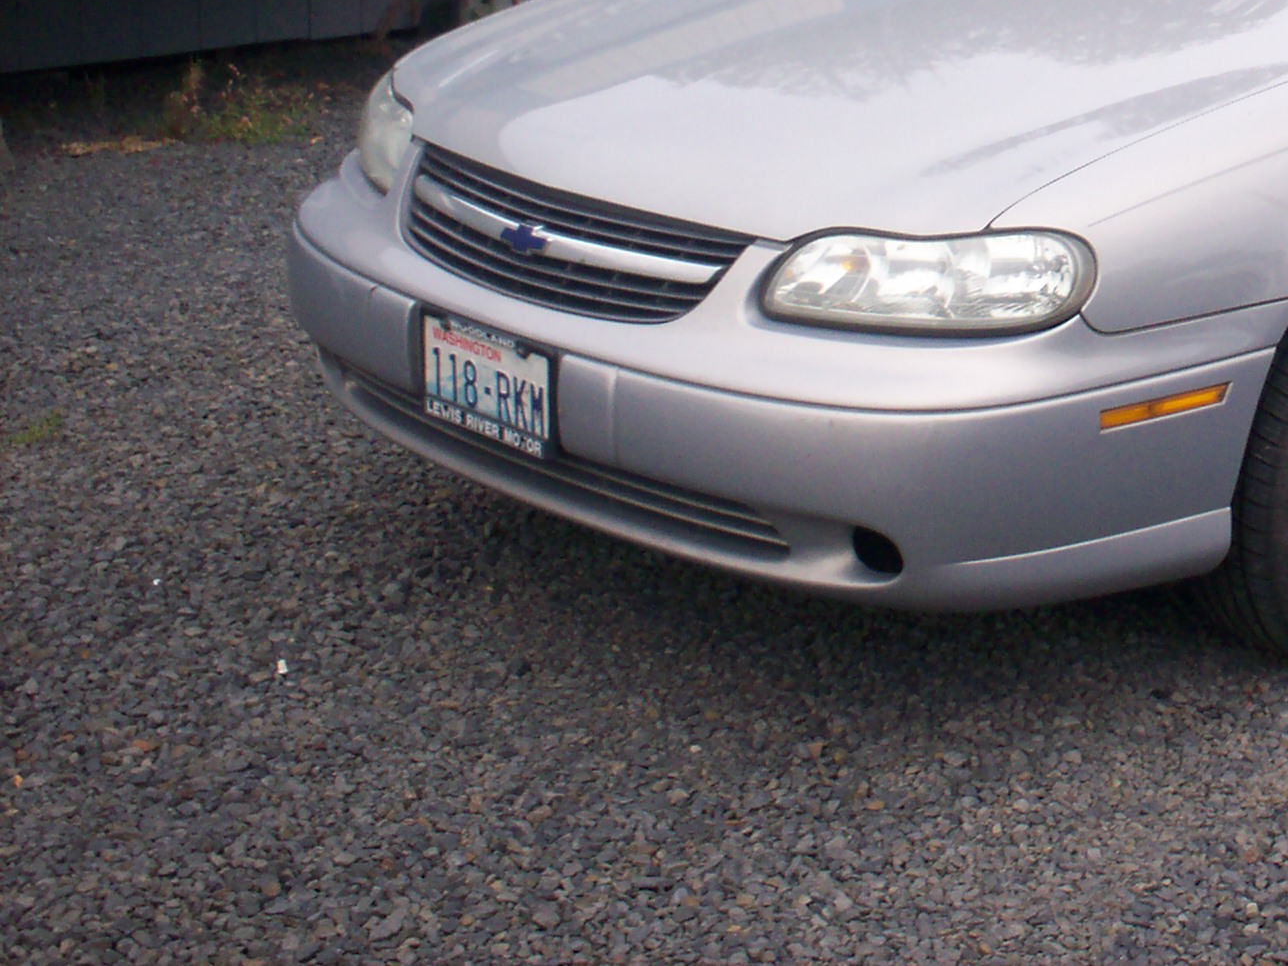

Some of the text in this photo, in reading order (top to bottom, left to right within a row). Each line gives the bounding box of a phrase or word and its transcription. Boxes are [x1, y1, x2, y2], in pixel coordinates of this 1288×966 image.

[432, 326, 501, 362] WASHINGTON
[432, 347, 544, 437] 118-RKM
[427, 399, 462, 424] LEWIS
[466, 413, 500, 439] RIVER
